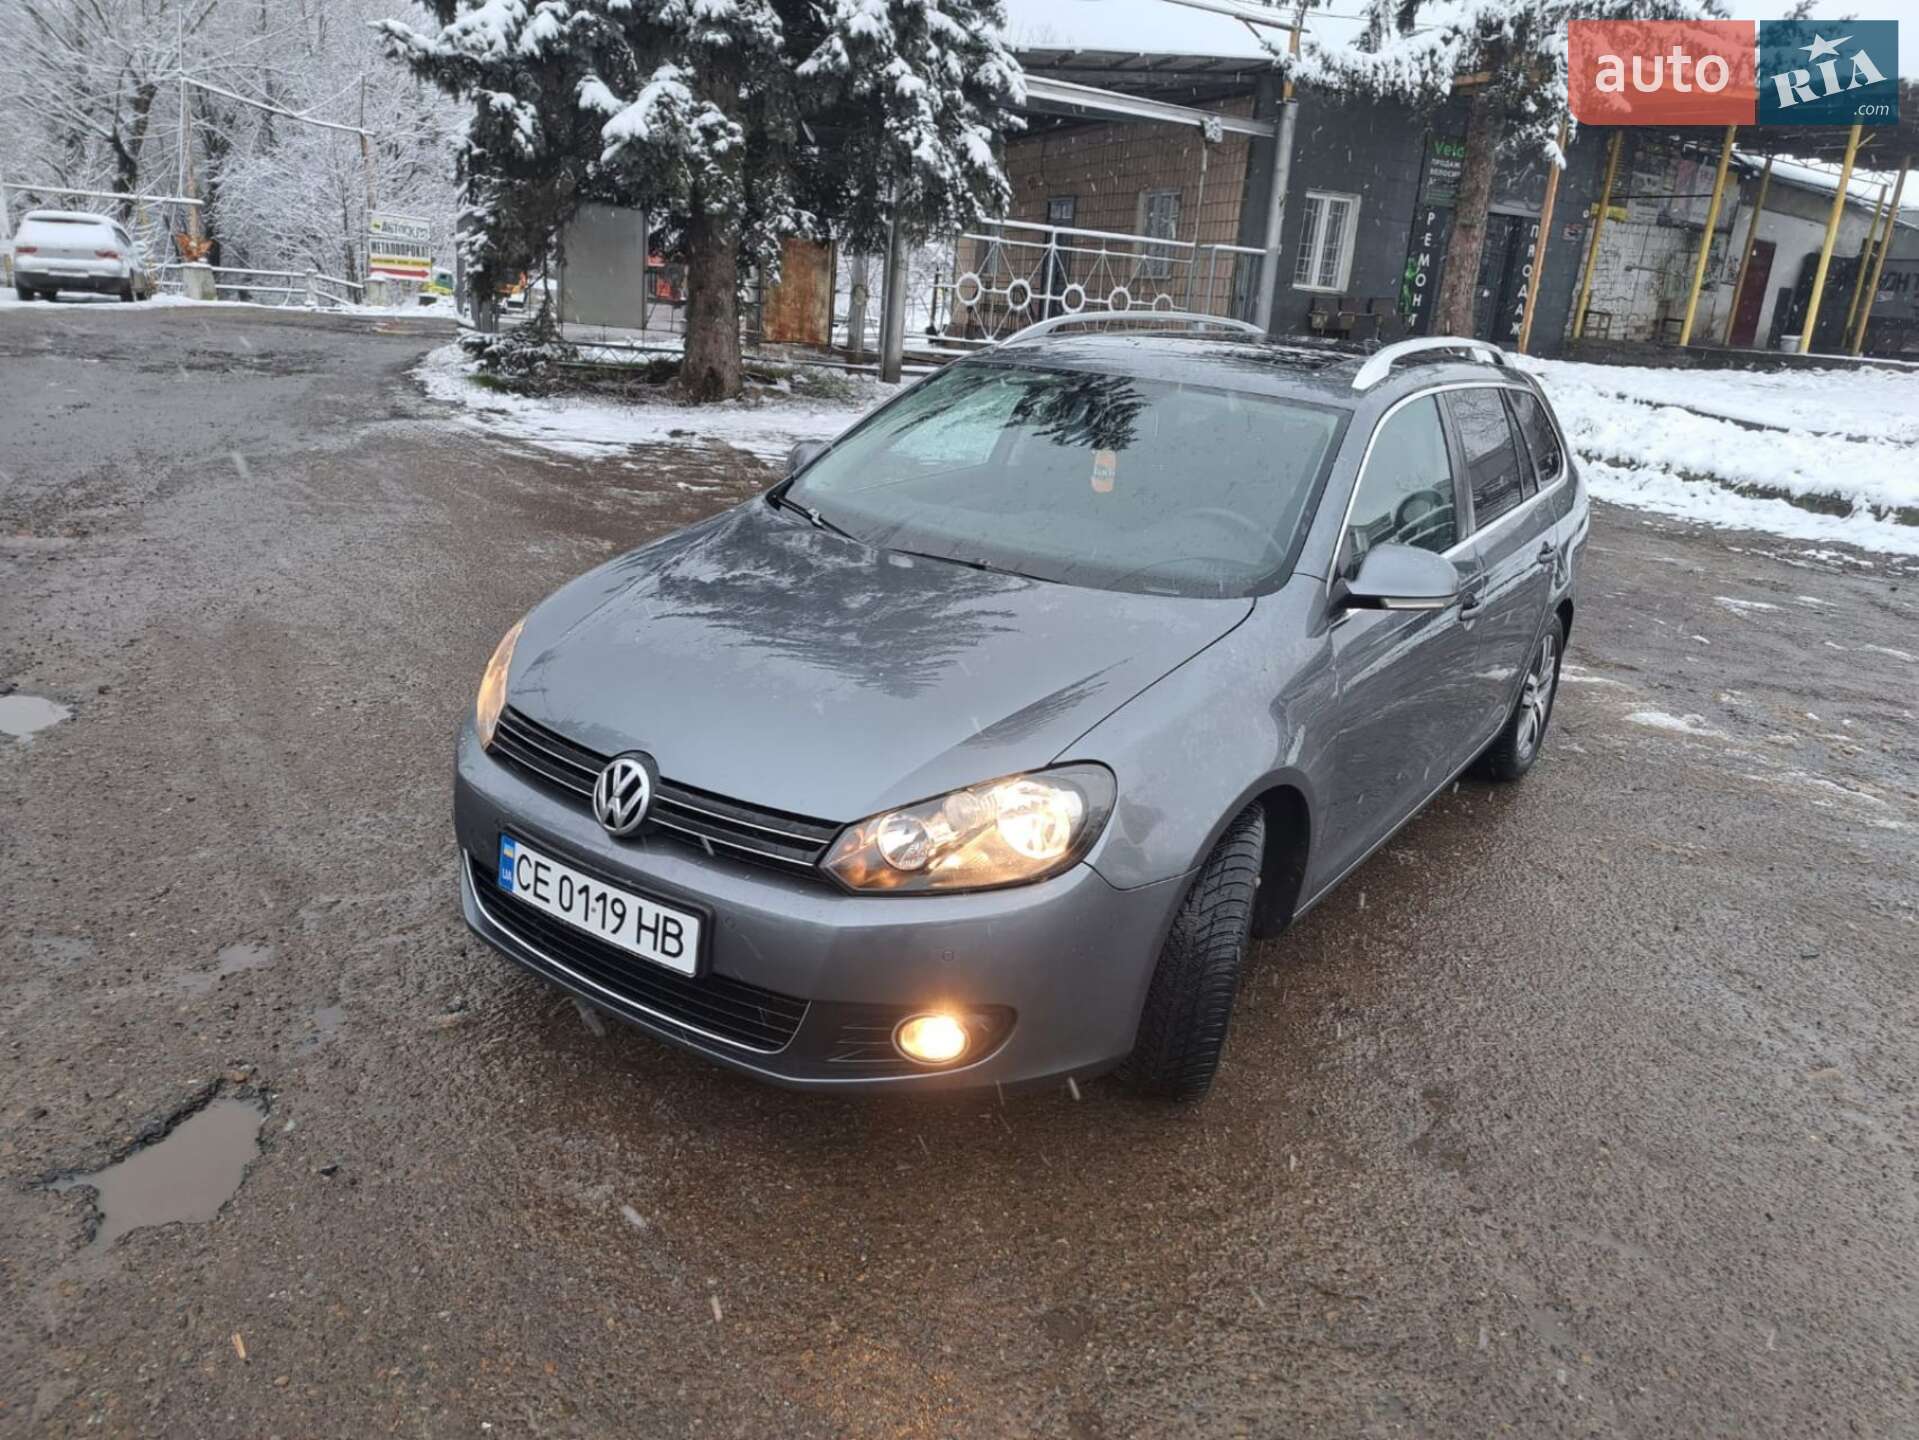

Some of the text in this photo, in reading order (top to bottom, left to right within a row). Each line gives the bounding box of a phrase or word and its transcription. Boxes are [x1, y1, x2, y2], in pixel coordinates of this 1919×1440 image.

[1408, 212, 1436, 327] РЕМОНТ
[516, 854, 684, 958] CE 0119 HB
